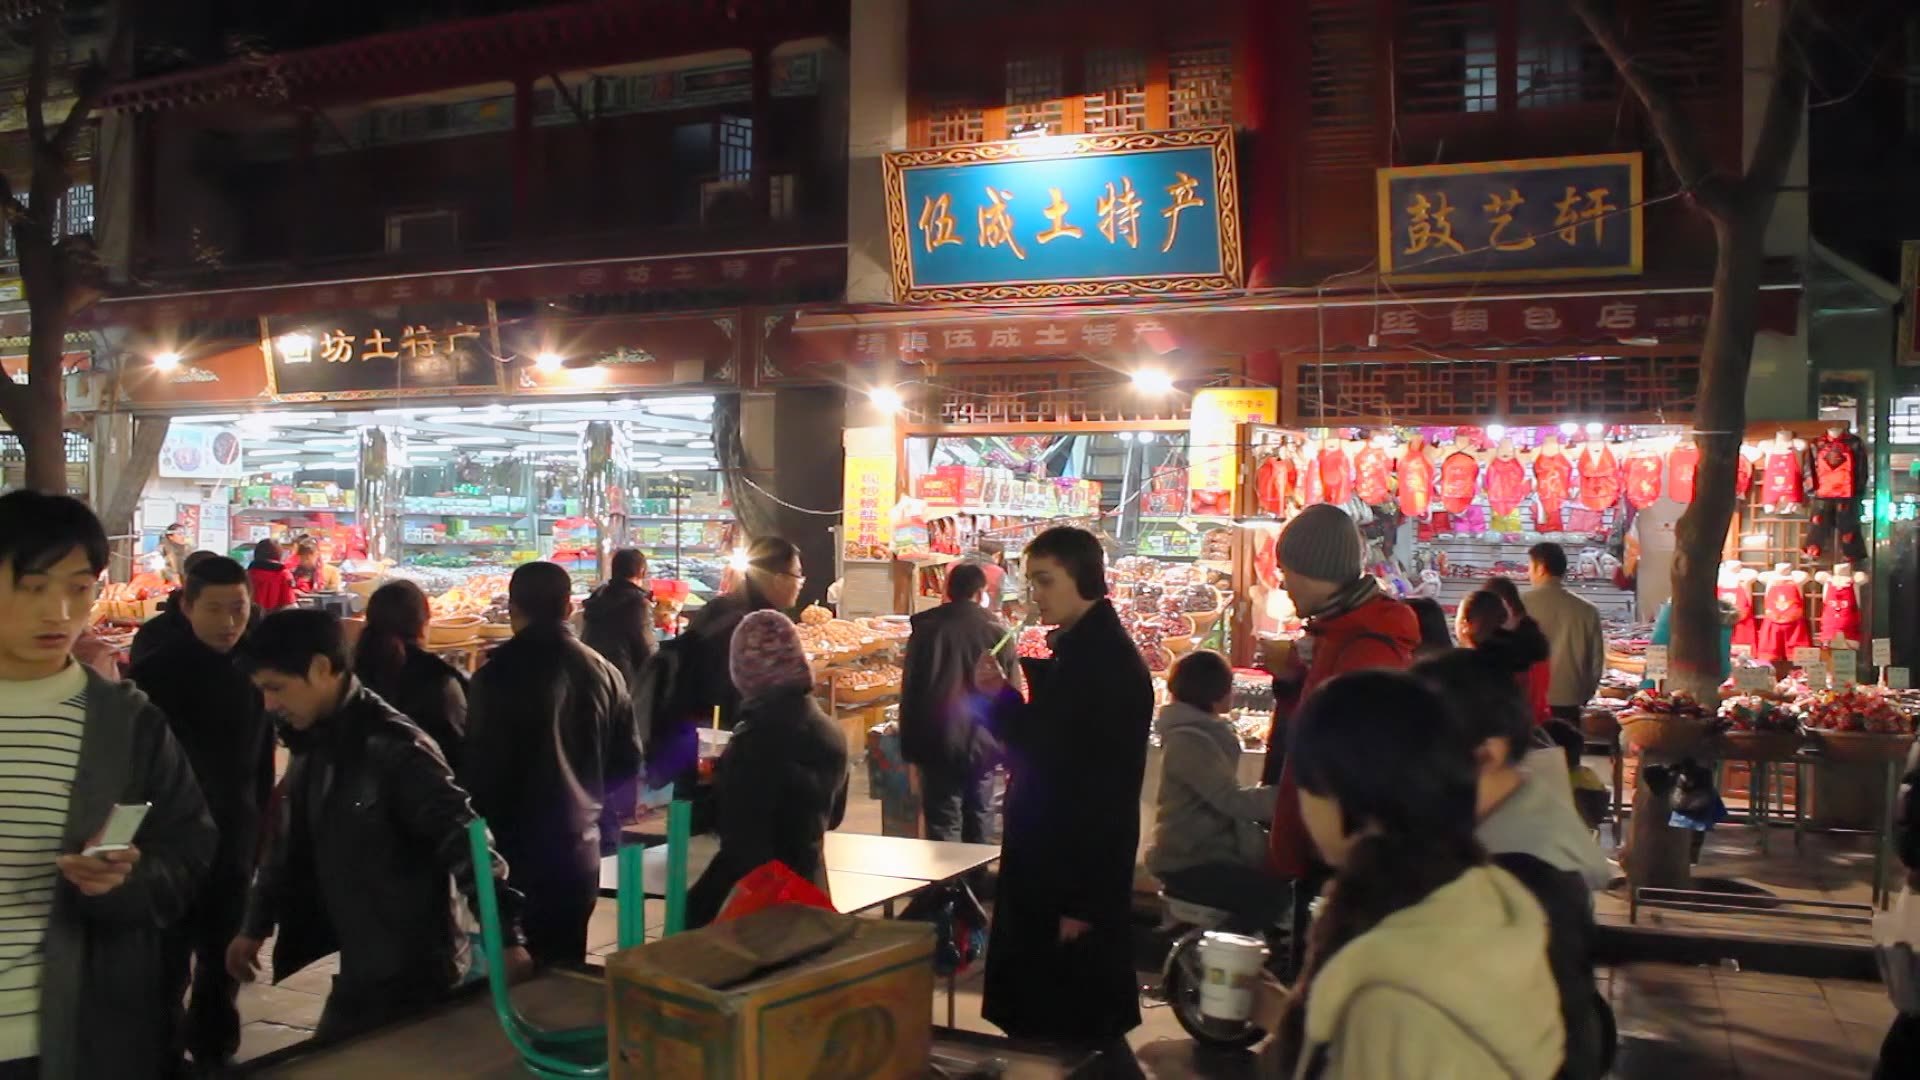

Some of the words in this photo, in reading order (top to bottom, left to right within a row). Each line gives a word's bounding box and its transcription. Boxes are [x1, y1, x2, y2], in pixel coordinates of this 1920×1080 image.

[917, 171, 1206, 260] 伍成土特产
[1402, 185, 1619, 254] 鼓艺轩
